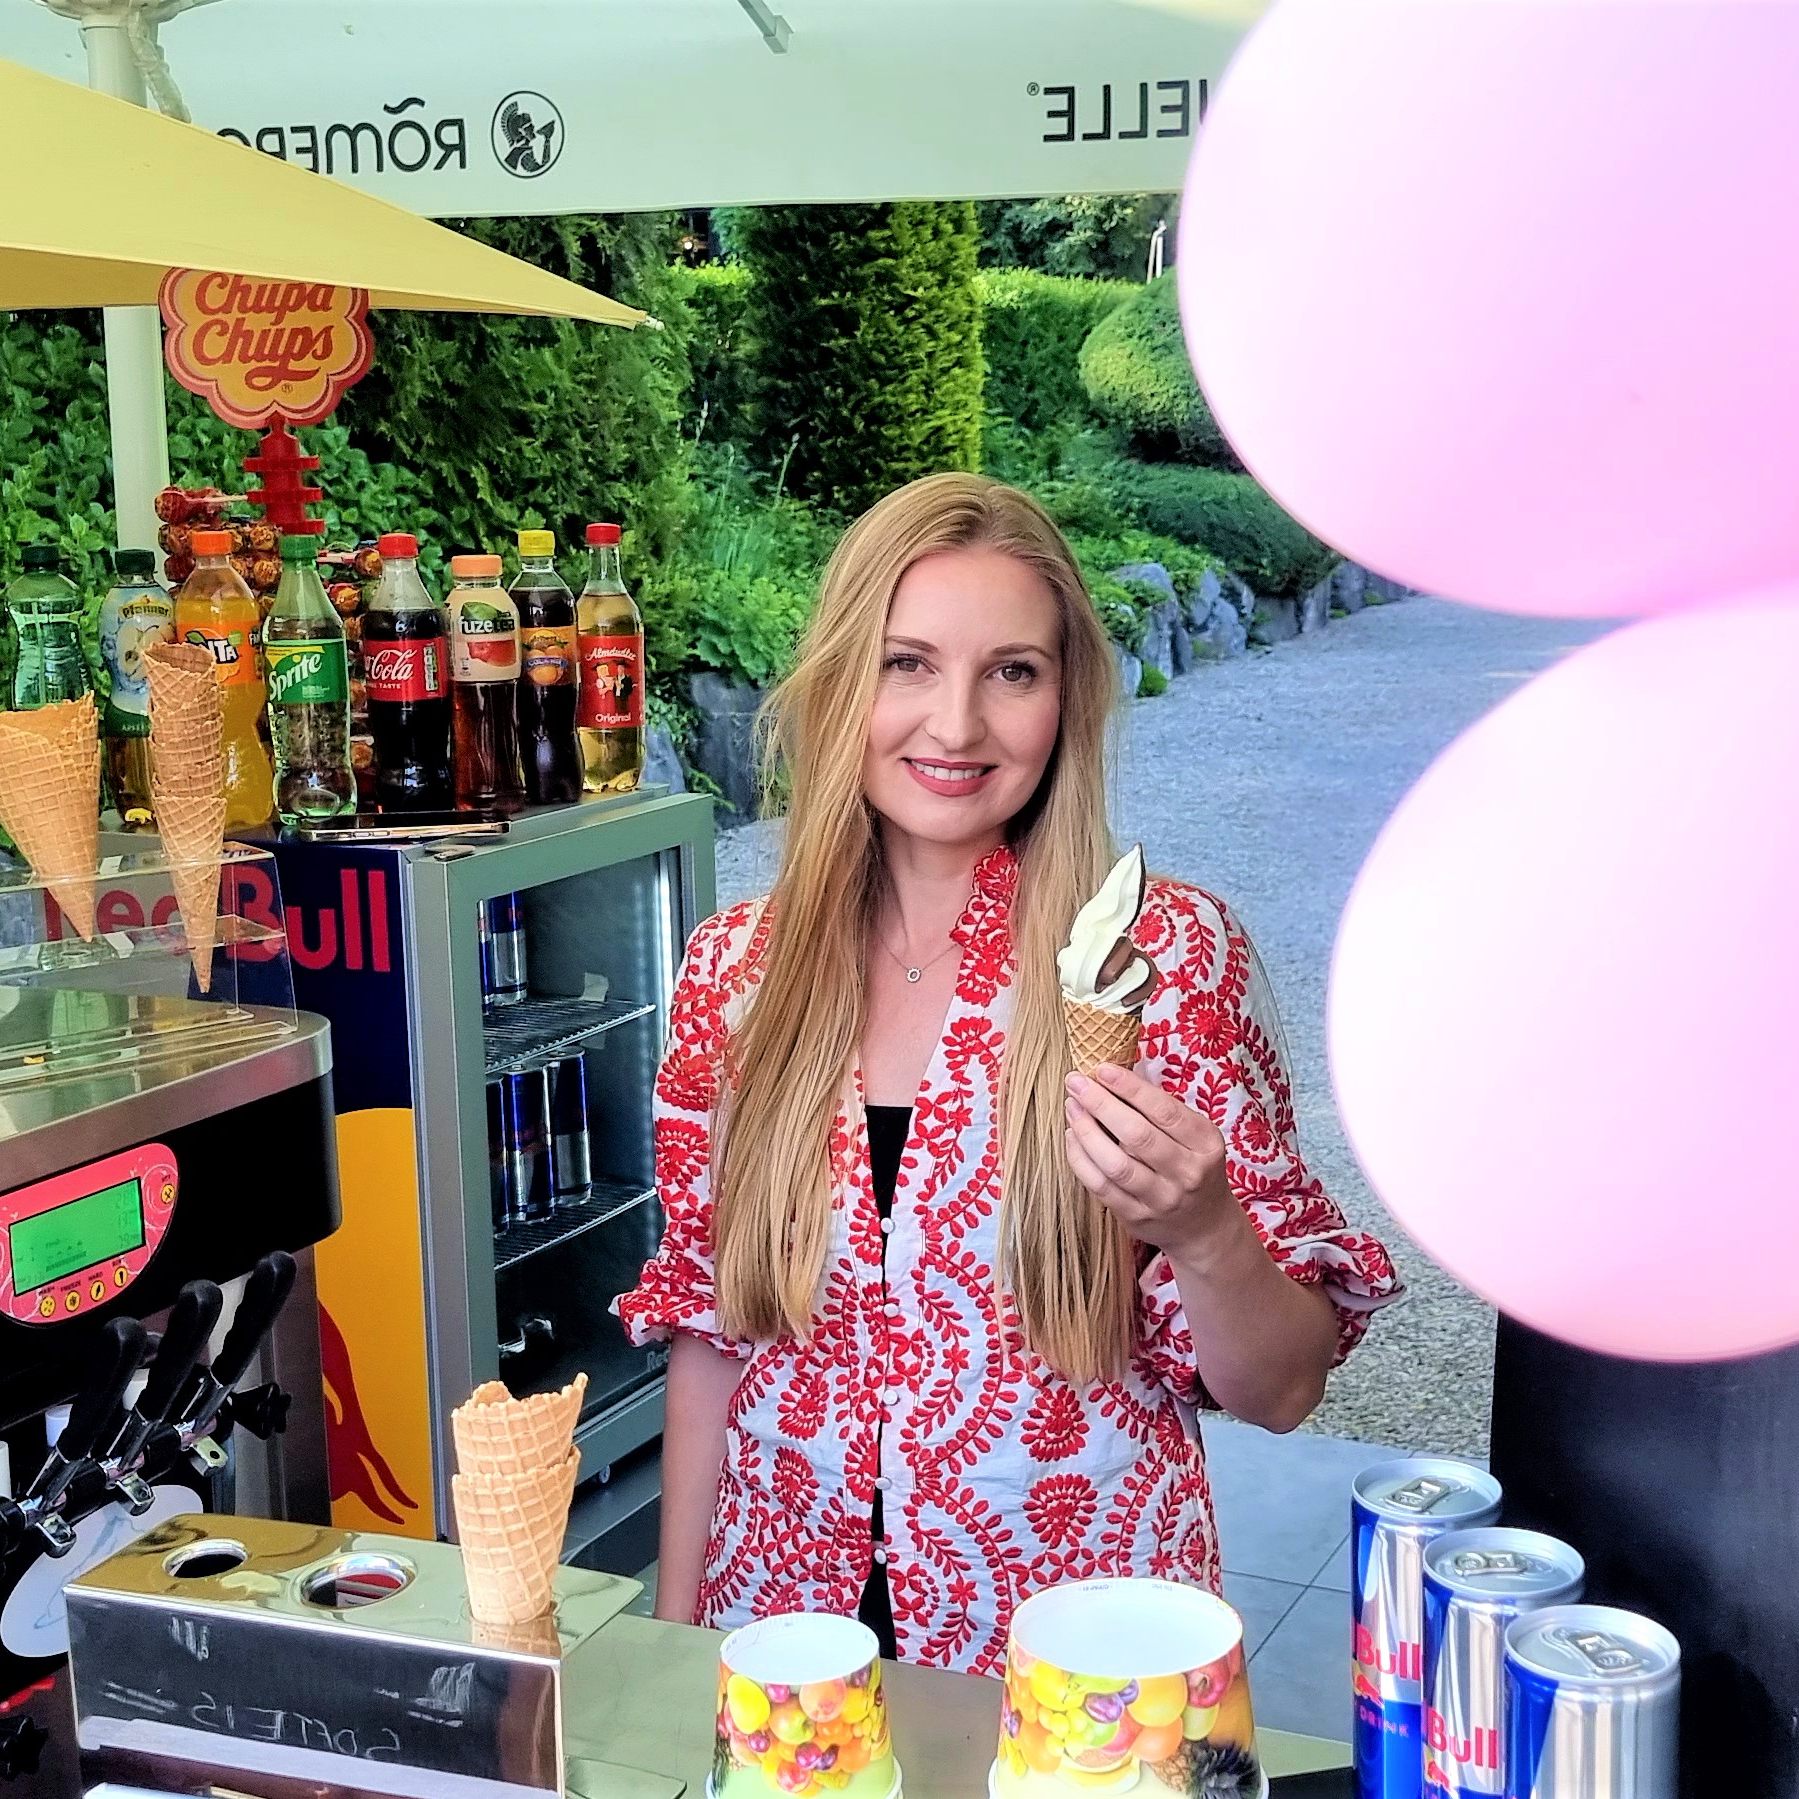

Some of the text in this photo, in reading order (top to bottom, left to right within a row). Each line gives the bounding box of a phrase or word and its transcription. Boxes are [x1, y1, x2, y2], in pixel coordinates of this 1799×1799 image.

[195, 272, 335, 325] Chupa
[192, 317, 335, 391] Chups
[458, 615, 493, 634] fuze
[269, 653, 323, 701] Sprite
[379, 682, 401, 690] TASTE
[595, 713, 632, 724] Original
[222, 865, 391, 973] Bull
[1356, 1624, 1421, 1681] Bull
[1428, 1706, 1498, 1770] Bull
